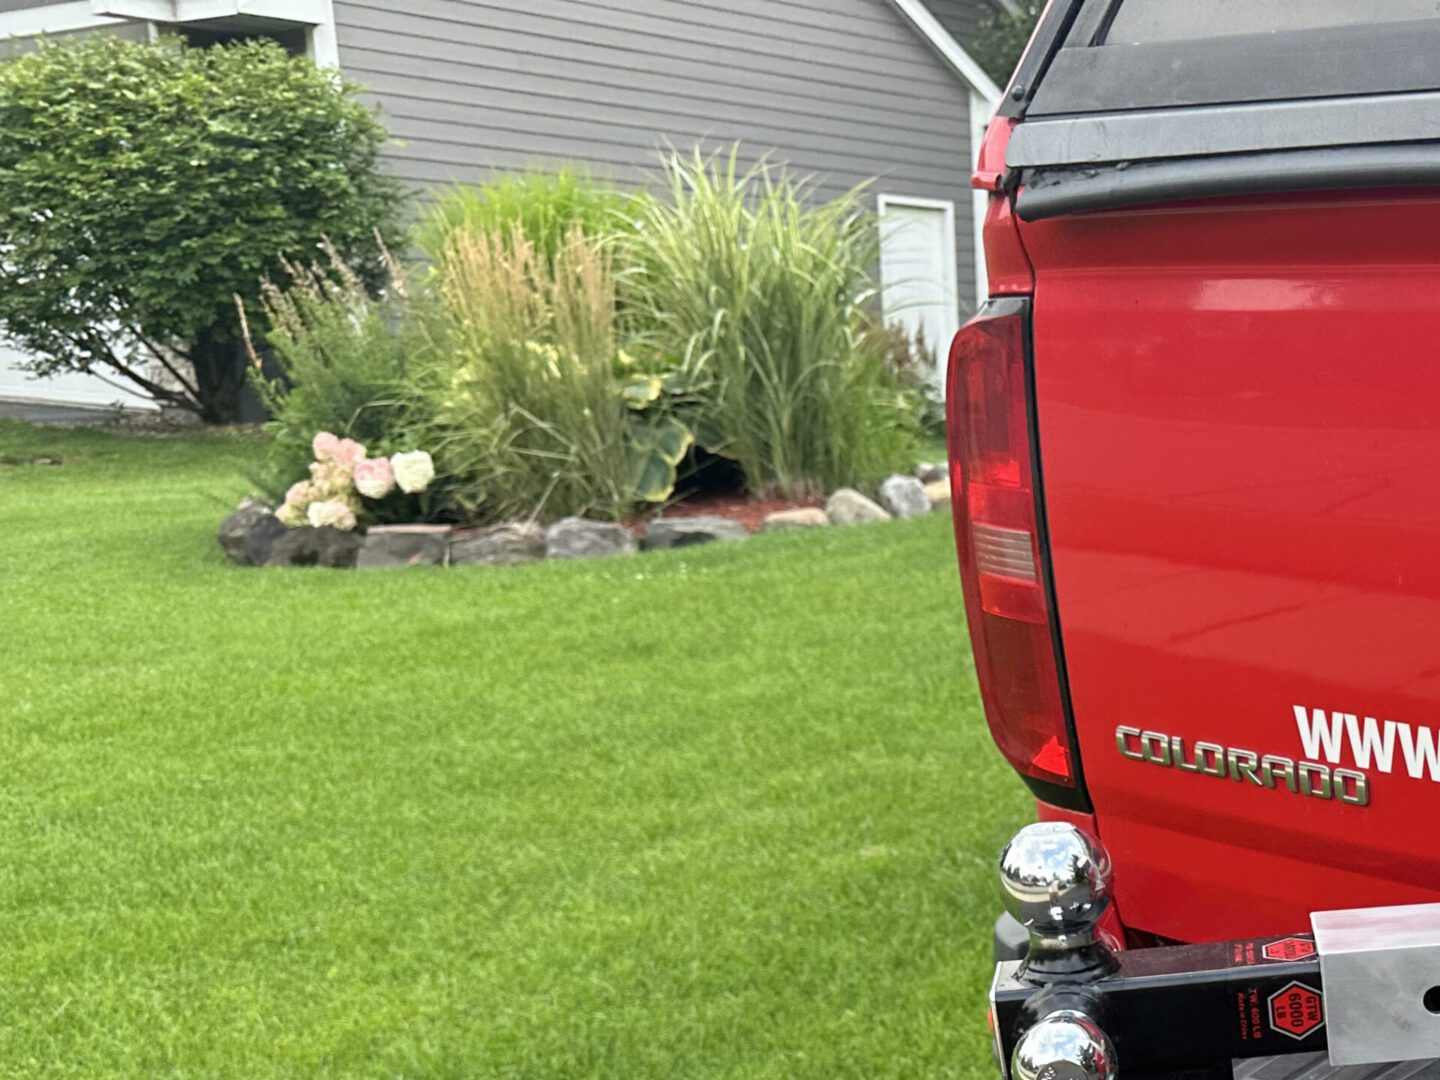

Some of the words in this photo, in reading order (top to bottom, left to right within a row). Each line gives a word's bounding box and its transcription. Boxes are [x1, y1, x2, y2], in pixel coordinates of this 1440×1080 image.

[1115, 725, 1370, 807] COLORADO
[1276, 1006, 1286, 1018] LB
[1289, 993, 1304, 1027] 6000
[1306, 996, 1319, 1021] GTW
